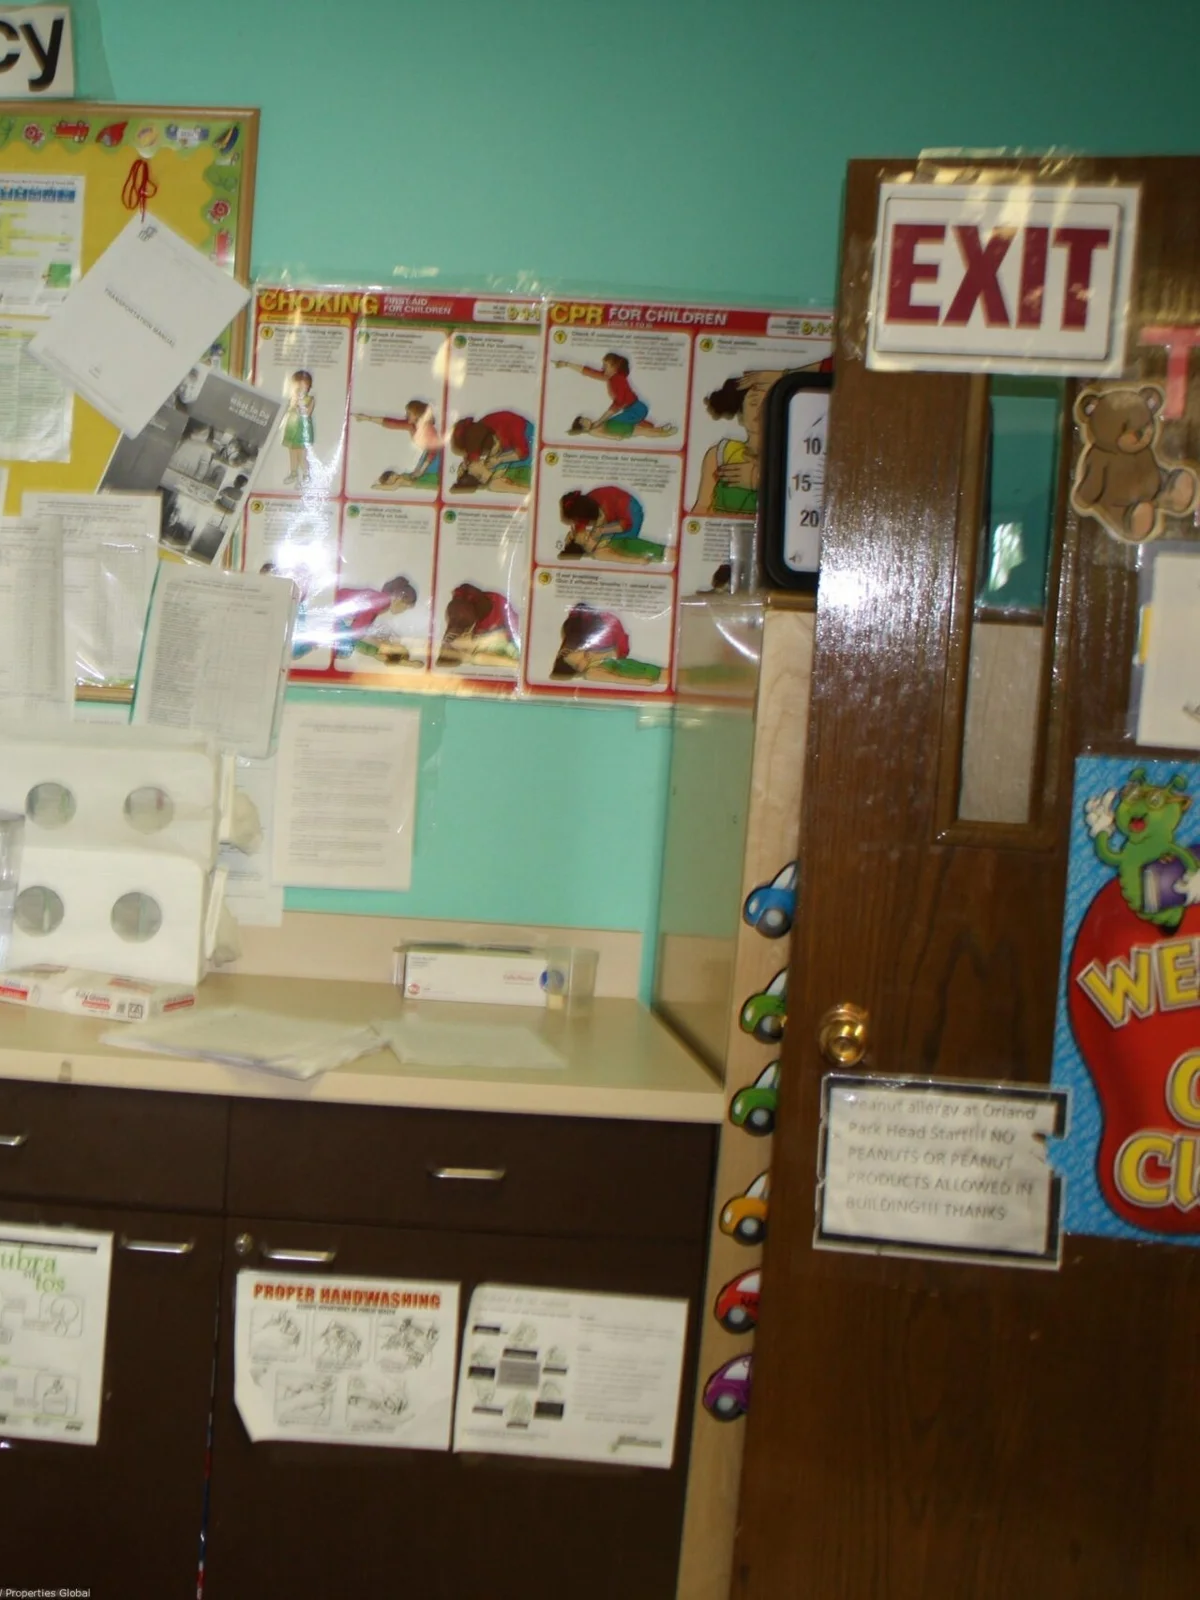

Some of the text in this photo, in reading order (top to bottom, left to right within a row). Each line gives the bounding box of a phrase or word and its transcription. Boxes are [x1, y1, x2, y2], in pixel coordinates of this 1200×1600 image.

[884, 223, 1111, 332] EXIT
[260, 292, 379, 316] CHOKING
[383, 304, 452, 316] FOR CHILDREN
[550, 302, 604, 326] CPR
[608, 306, 641, 321] FOR
[645, 309, 728, 327] CHILDREN
[803, 437, 822, 456] 10
[792, 474, 812, 493] 15
[800, 509, 819, 528] 20
[1076, 937, 1200, 1029] WE
[907, 1101, 959, 1119] allergy
[963, 1104, 978, 1117] at
[981, 1103, 1037, 1120] Orland
[847, 1121, 882, 1137] Park
[886, 1123, 927, 1140] Head
[990, 1128, 1017, 1145] NO
[847, 1145, 1014, 1170] PEANUTS OR PEANUT
[846, 1171, 1034, 1197] PRODUCTS ALLOWED IN
[943, 1202, 1008, 1221] THANKS
[253, 1282, 442, 1310] PROPER HANDWASHING
